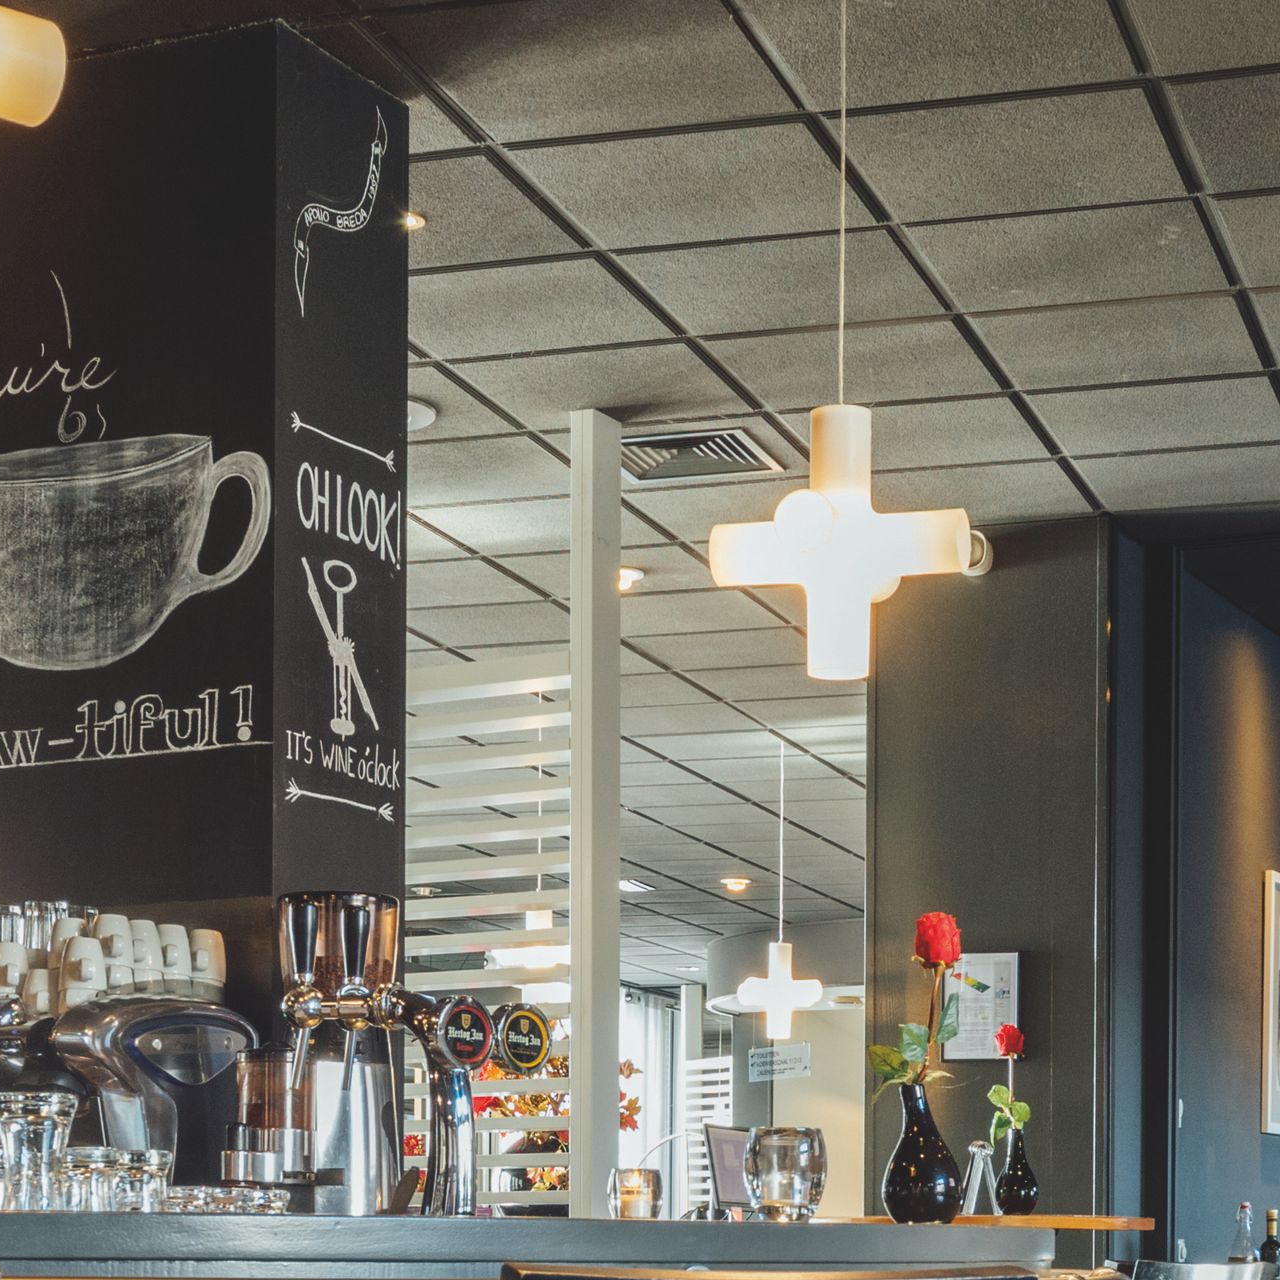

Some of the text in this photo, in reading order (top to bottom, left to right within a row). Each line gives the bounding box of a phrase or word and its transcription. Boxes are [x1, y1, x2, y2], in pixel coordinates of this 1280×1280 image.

[304, 207, 330, 227] APOLLO
[336, 208, 368, 228] BREDA
[296, 461, 402, 571] OH LOOK!
[285, 729, 314, 765] IT'S
[319, 739, 356, 779] WINE
[447, 1026, 484, 1042] Hertog Jan
[508, 1030, 541, 1046] Hertog Jan
